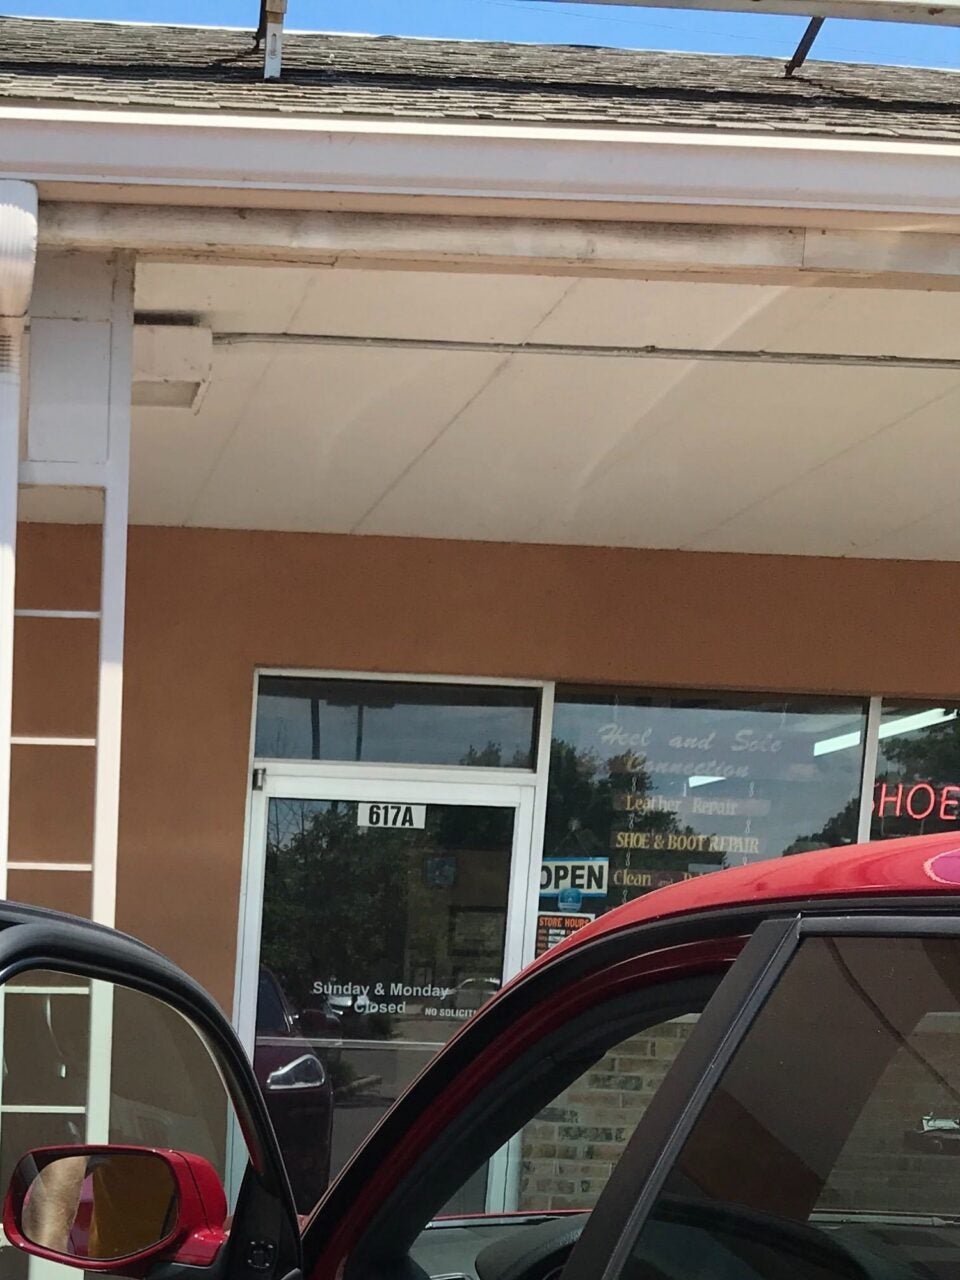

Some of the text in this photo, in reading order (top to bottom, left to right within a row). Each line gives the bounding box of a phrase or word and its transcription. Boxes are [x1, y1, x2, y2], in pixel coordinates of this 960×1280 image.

[669, 732, 716, 750] and
[626, 795, 738, 815] Leather Repair
[871, 783, 960, 820] HOE
[368, 805, 414, 827] 617A
[615, 831, 759, 853] SHOE & BOOT REPAIR
[540, 864, 604, 890] OPEN
[613, 869, 652, 887] Clean
[539, 917, 562, 927] STORE
[312, 981, 449, 1001] Sunday & Monday
[353, 1001, 406, 1014] Closed
[424, 1008, 438, 1017] NO
